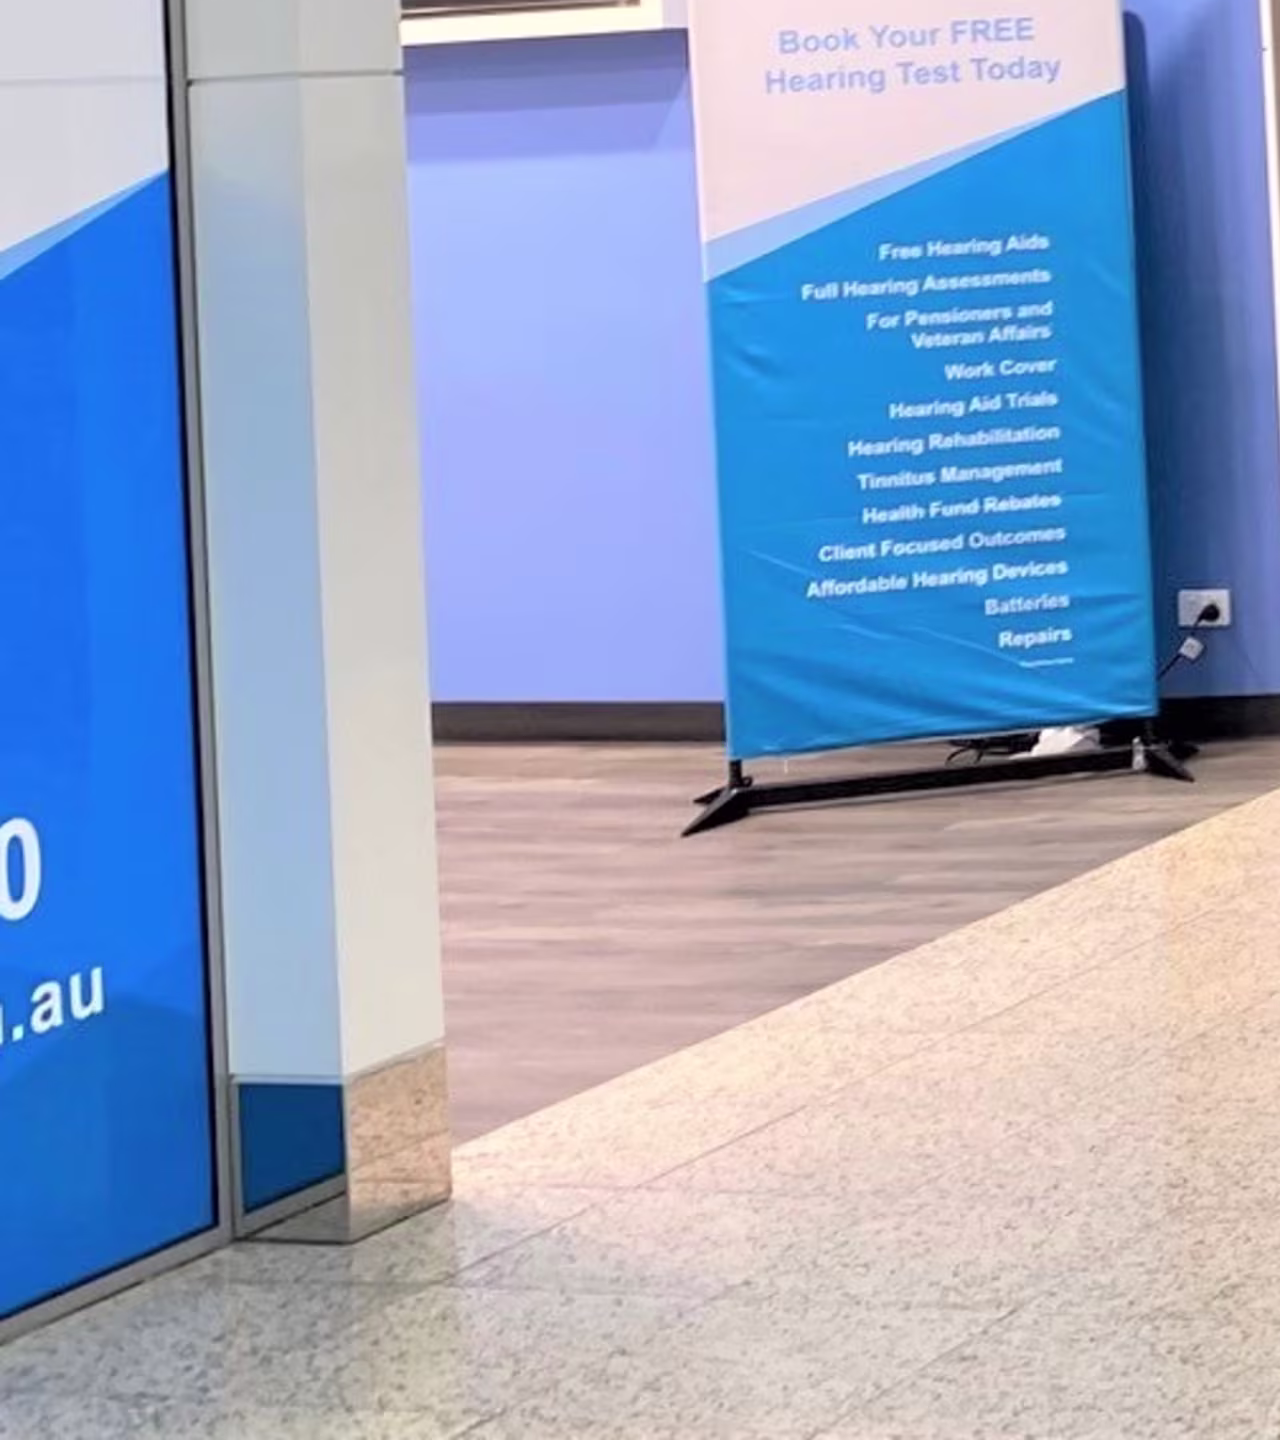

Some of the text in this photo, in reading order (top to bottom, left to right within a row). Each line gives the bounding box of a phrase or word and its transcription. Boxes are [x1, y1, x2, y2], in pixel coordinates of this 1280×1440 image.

[778, 17, 1034, 54] Book Your FREE
[764, 56, 1062, 94] Hearing Test Today
[878, 233, 1050, 261] Free Hearing Aids
[801, 268, 1052, 301] Full Hearing Assessments
[865, 300, 1054, 331] For Pensioners and
[911, 324, 1052, 349] Veteran Affairs
[944, 358, 1057, 380] Work Cover
[888, 391, 1059, 420] Hearing Aid Trials
[848, 425, 1061, 457] Hearing Rehabilitation
[856, 458, 1064, 491] Tinnitus Management
[862, 492, 1063, 525] Health Fund Rebates
[818, 525, 1067, 563] Client Focused Outcomes
[806, 559, 1069, 599] Affordable Hearing Devices
[984, 592, 1071, 616] Batteries
[998, 627, 1073, 649] Repairs
[0, 965, 105, 1045] .au
